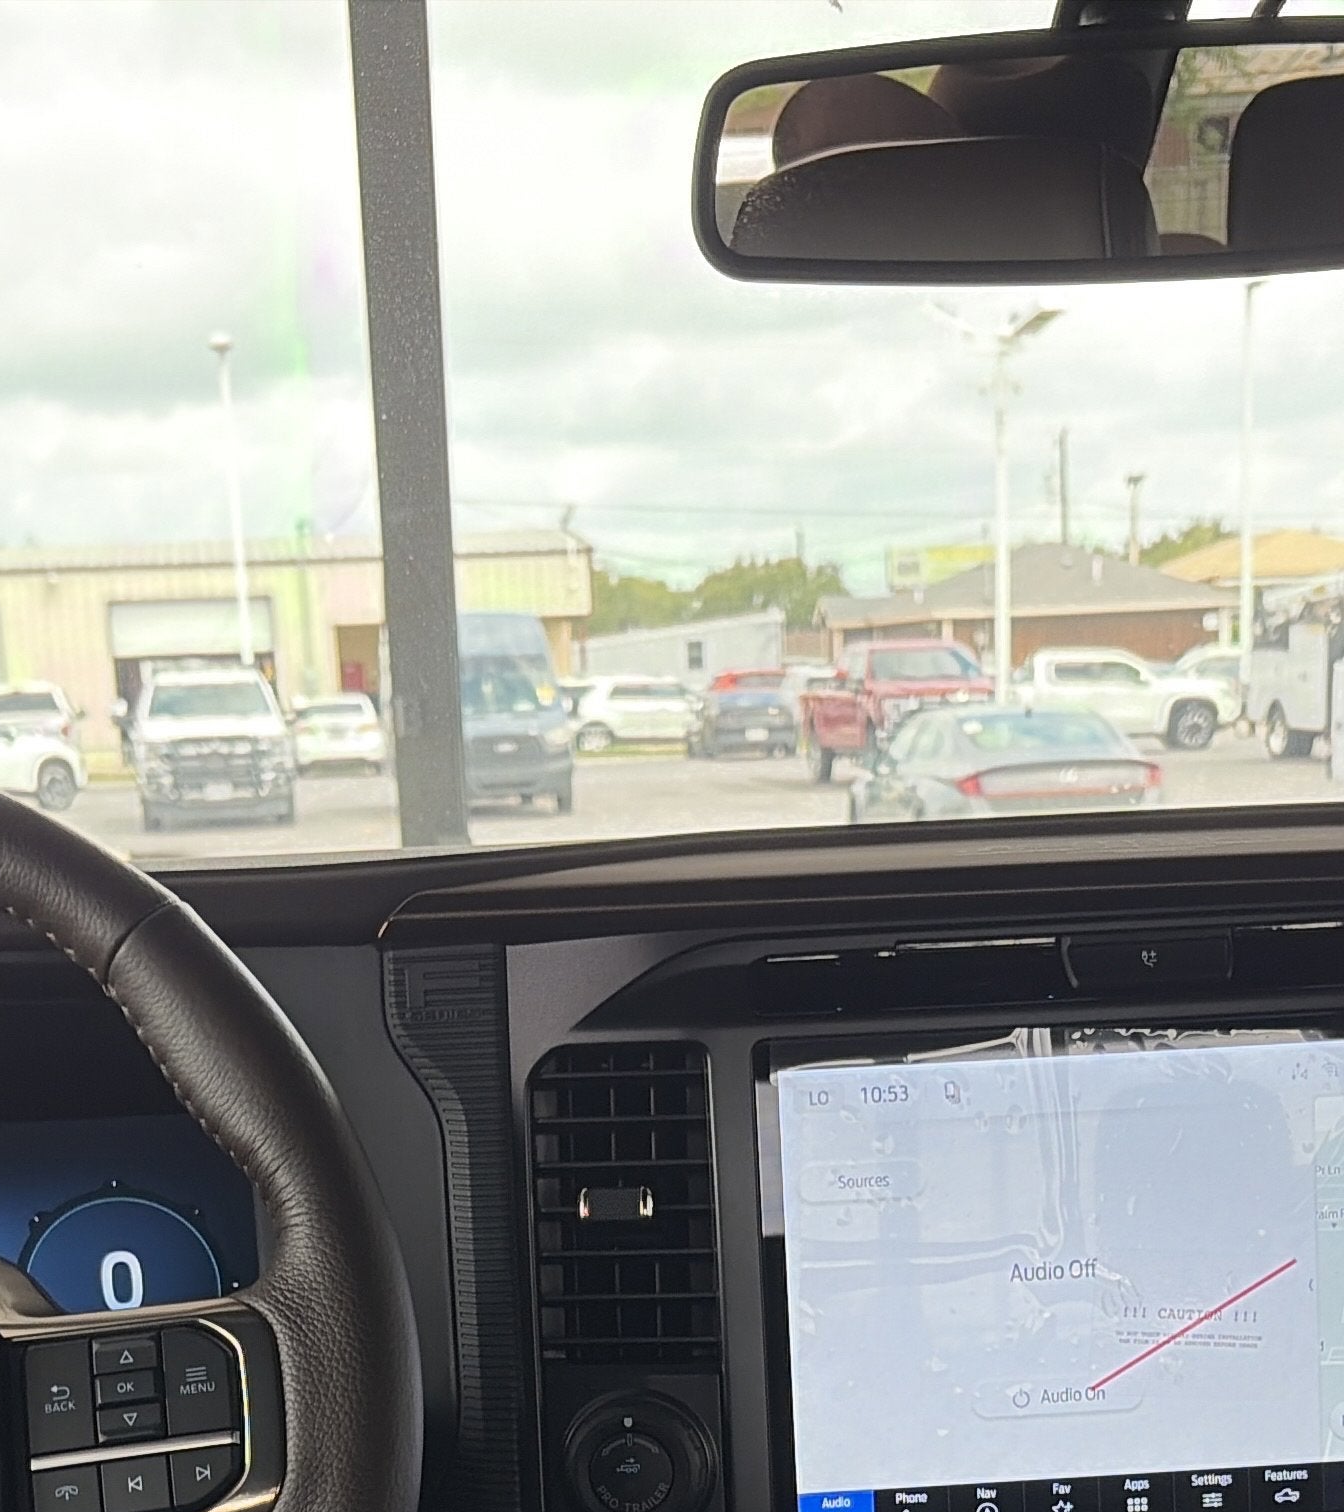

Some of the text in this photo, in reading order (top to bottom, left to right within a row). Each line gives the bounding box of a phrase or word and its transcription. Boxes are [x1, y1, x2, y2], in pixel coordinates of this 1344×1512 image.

[809, 1090, 829, 1105] LO
[860, 1085, 909, 1104] 10:53
[837, 1173, 890, 1190] Sources
[1010, 1258, 1098, 1282] Audio Off
[100, 1251, 144, 1311] 0
[117, 1382, 134, 1393] OK
[179, 1381, 216, 1395] MENU
[1041, 1386, 1106, 1404] Audio On
[44, 1399, 76, 1414] BACK
[1191, 1472, 1233, 1488] Settings
[1264, 1468, 1309, 1482] Features
[1052, 1482, 1072, 1496] Fav
[1124, 1478, 1150, 1492] Apps
[596, 1482, 670, 1512] PRO TRAILER
[895, 1491, 928, 1505] Phone
[976, 1487, 997, 1499] Nav
[821, 1496, 851, 1509] Audio
